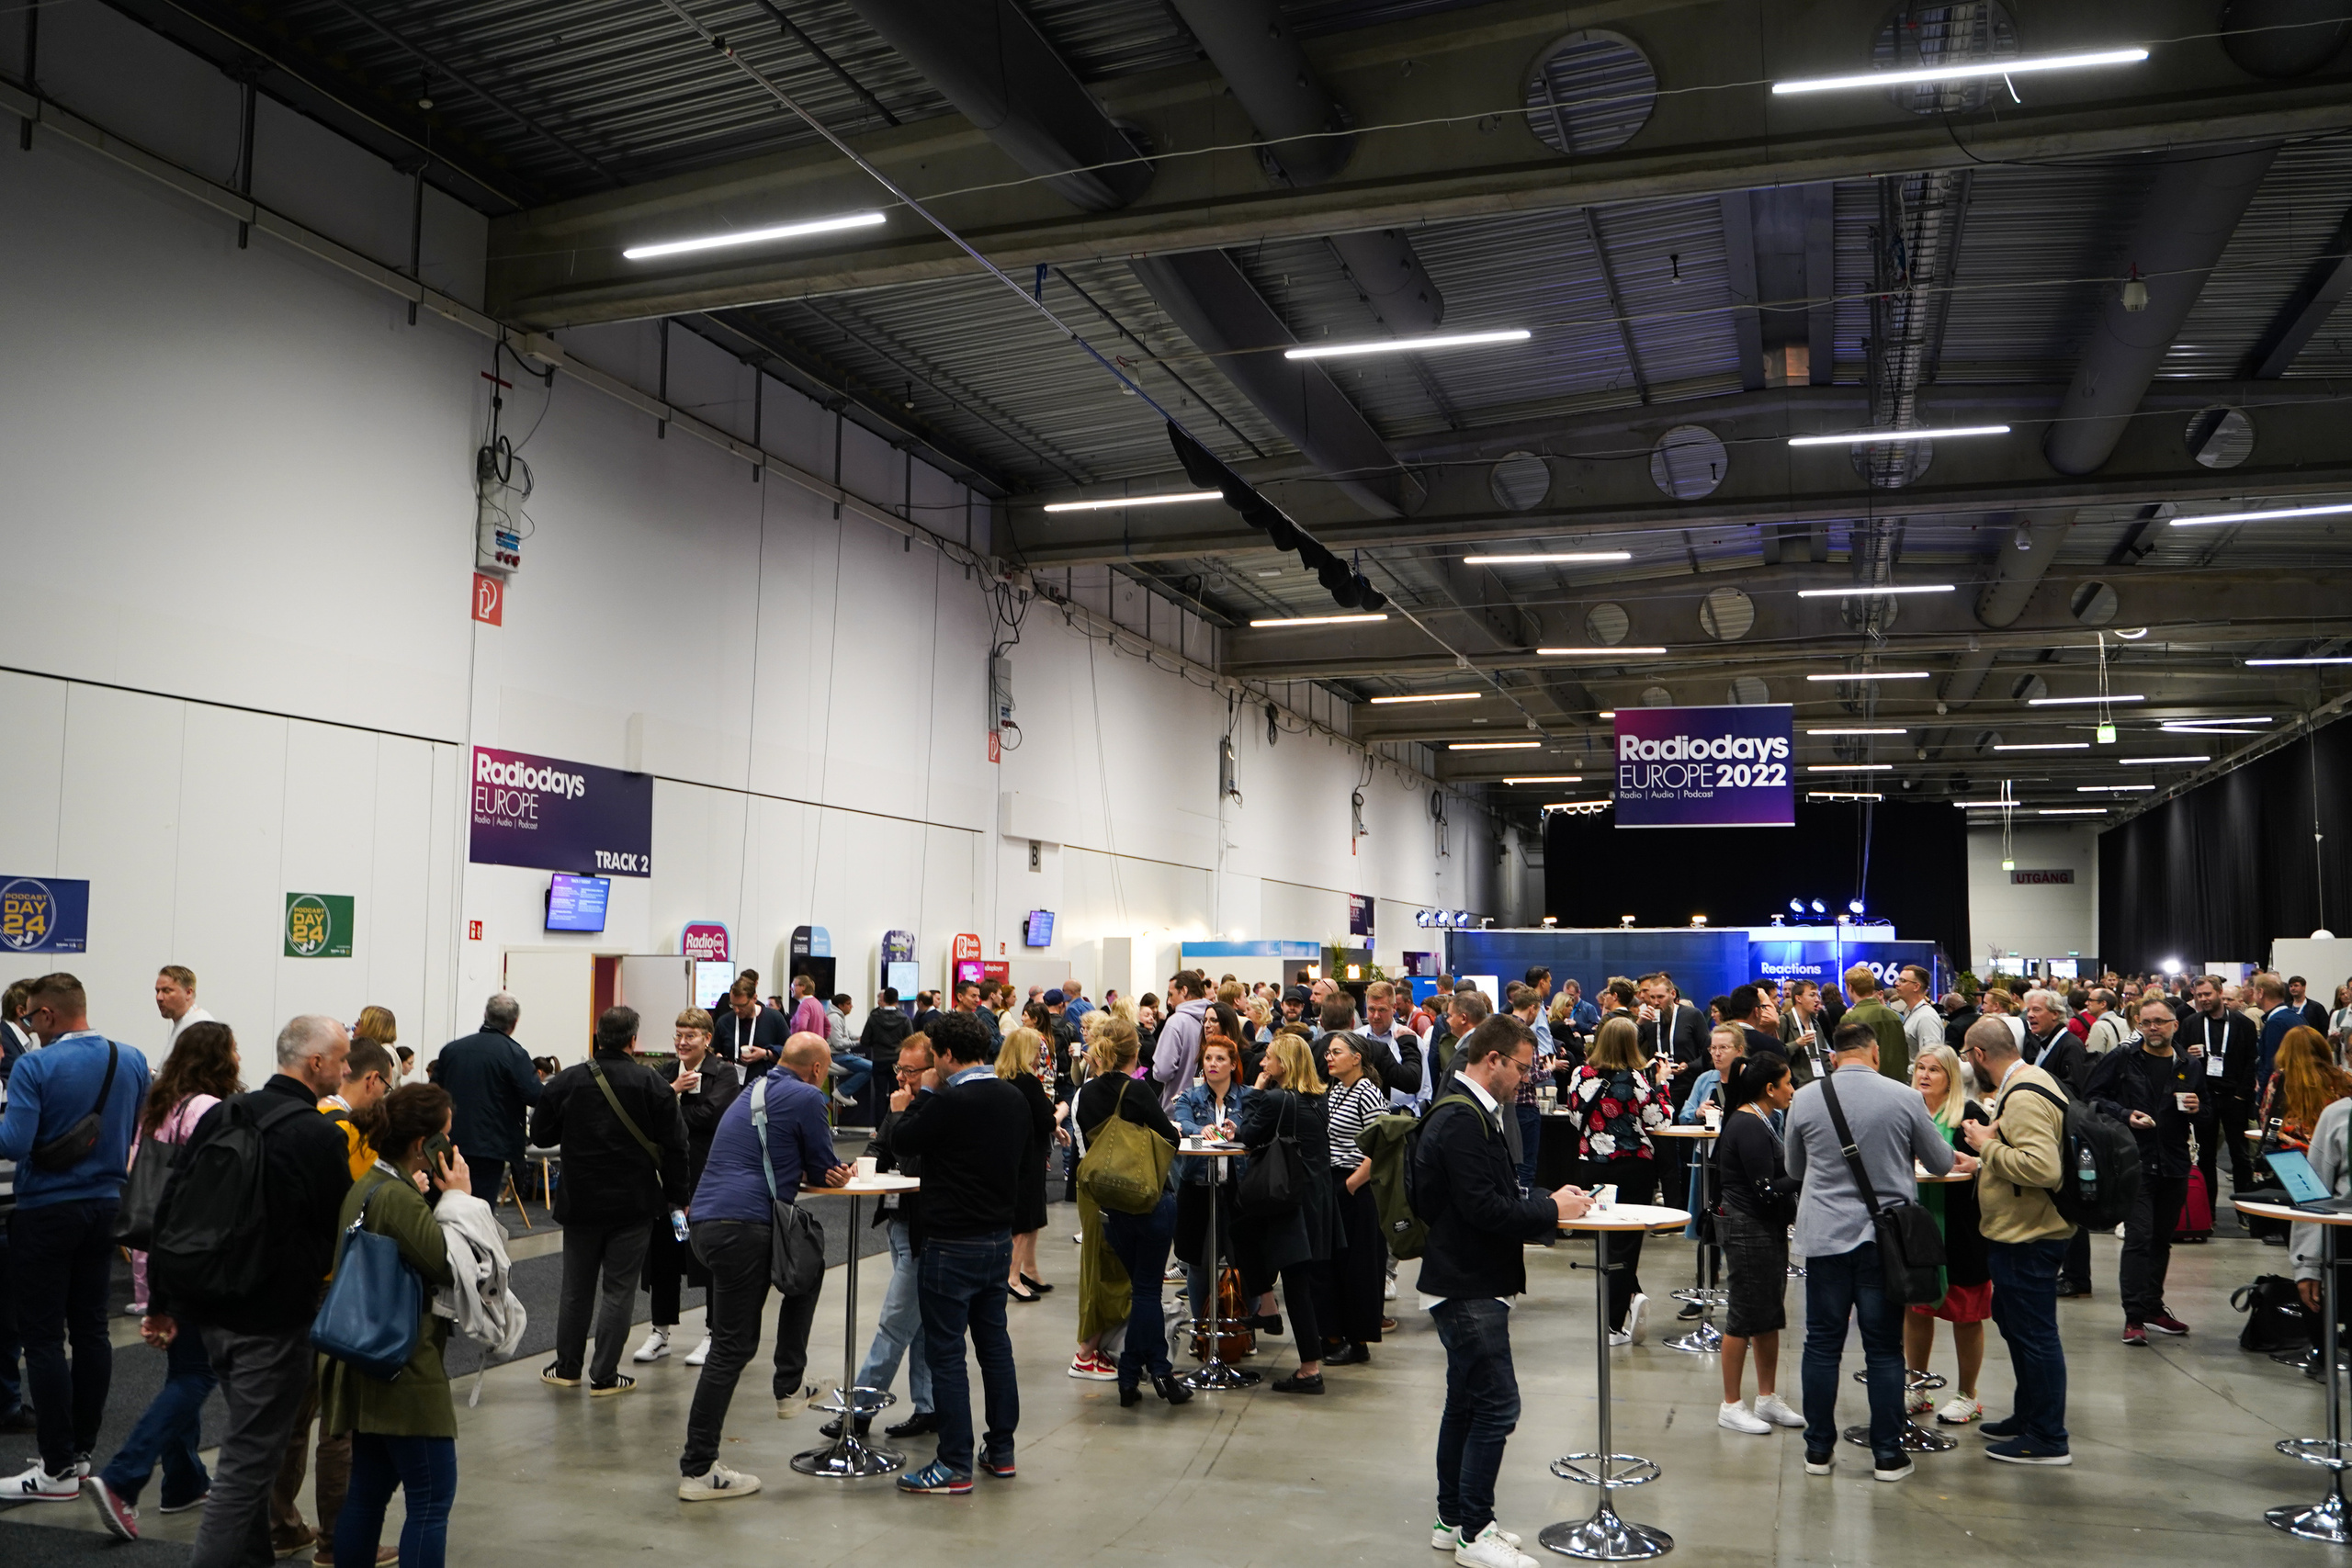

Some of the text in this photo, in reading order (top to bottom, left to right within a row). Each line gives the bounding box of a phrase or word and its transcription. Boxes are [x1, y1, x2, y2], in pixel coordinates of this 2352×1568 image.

[1620, 734, 1789, 763] Radiodays
[476, 752, 585, 800] Radiodays
[1620, 763, 1787, 789] EUROPE 2022
[475, 786, 539, 820] EUROPE
[1620, 790, 1713, 799] Radio Audio Podcast
[474, 814, 538, 830] Radio Audio Podcast
[595, 850, 649, 873] TRACK 2
[1032, 845, 1038, 866] B
[2016, 870, 2069, 884] UTGÅNG
[5, 892, 48, 901] PODCAST
[5, 900, 47, 914] DAY
[4, 914, 46, 935] 24
[294, 913, 324, 925] DAY
[293, 924, 323, 943] 24
[685, 932, 713, 949] Radio
[1761, 962, 1822, 975] Reactions
[1854, 961, 1900, 986] 96
